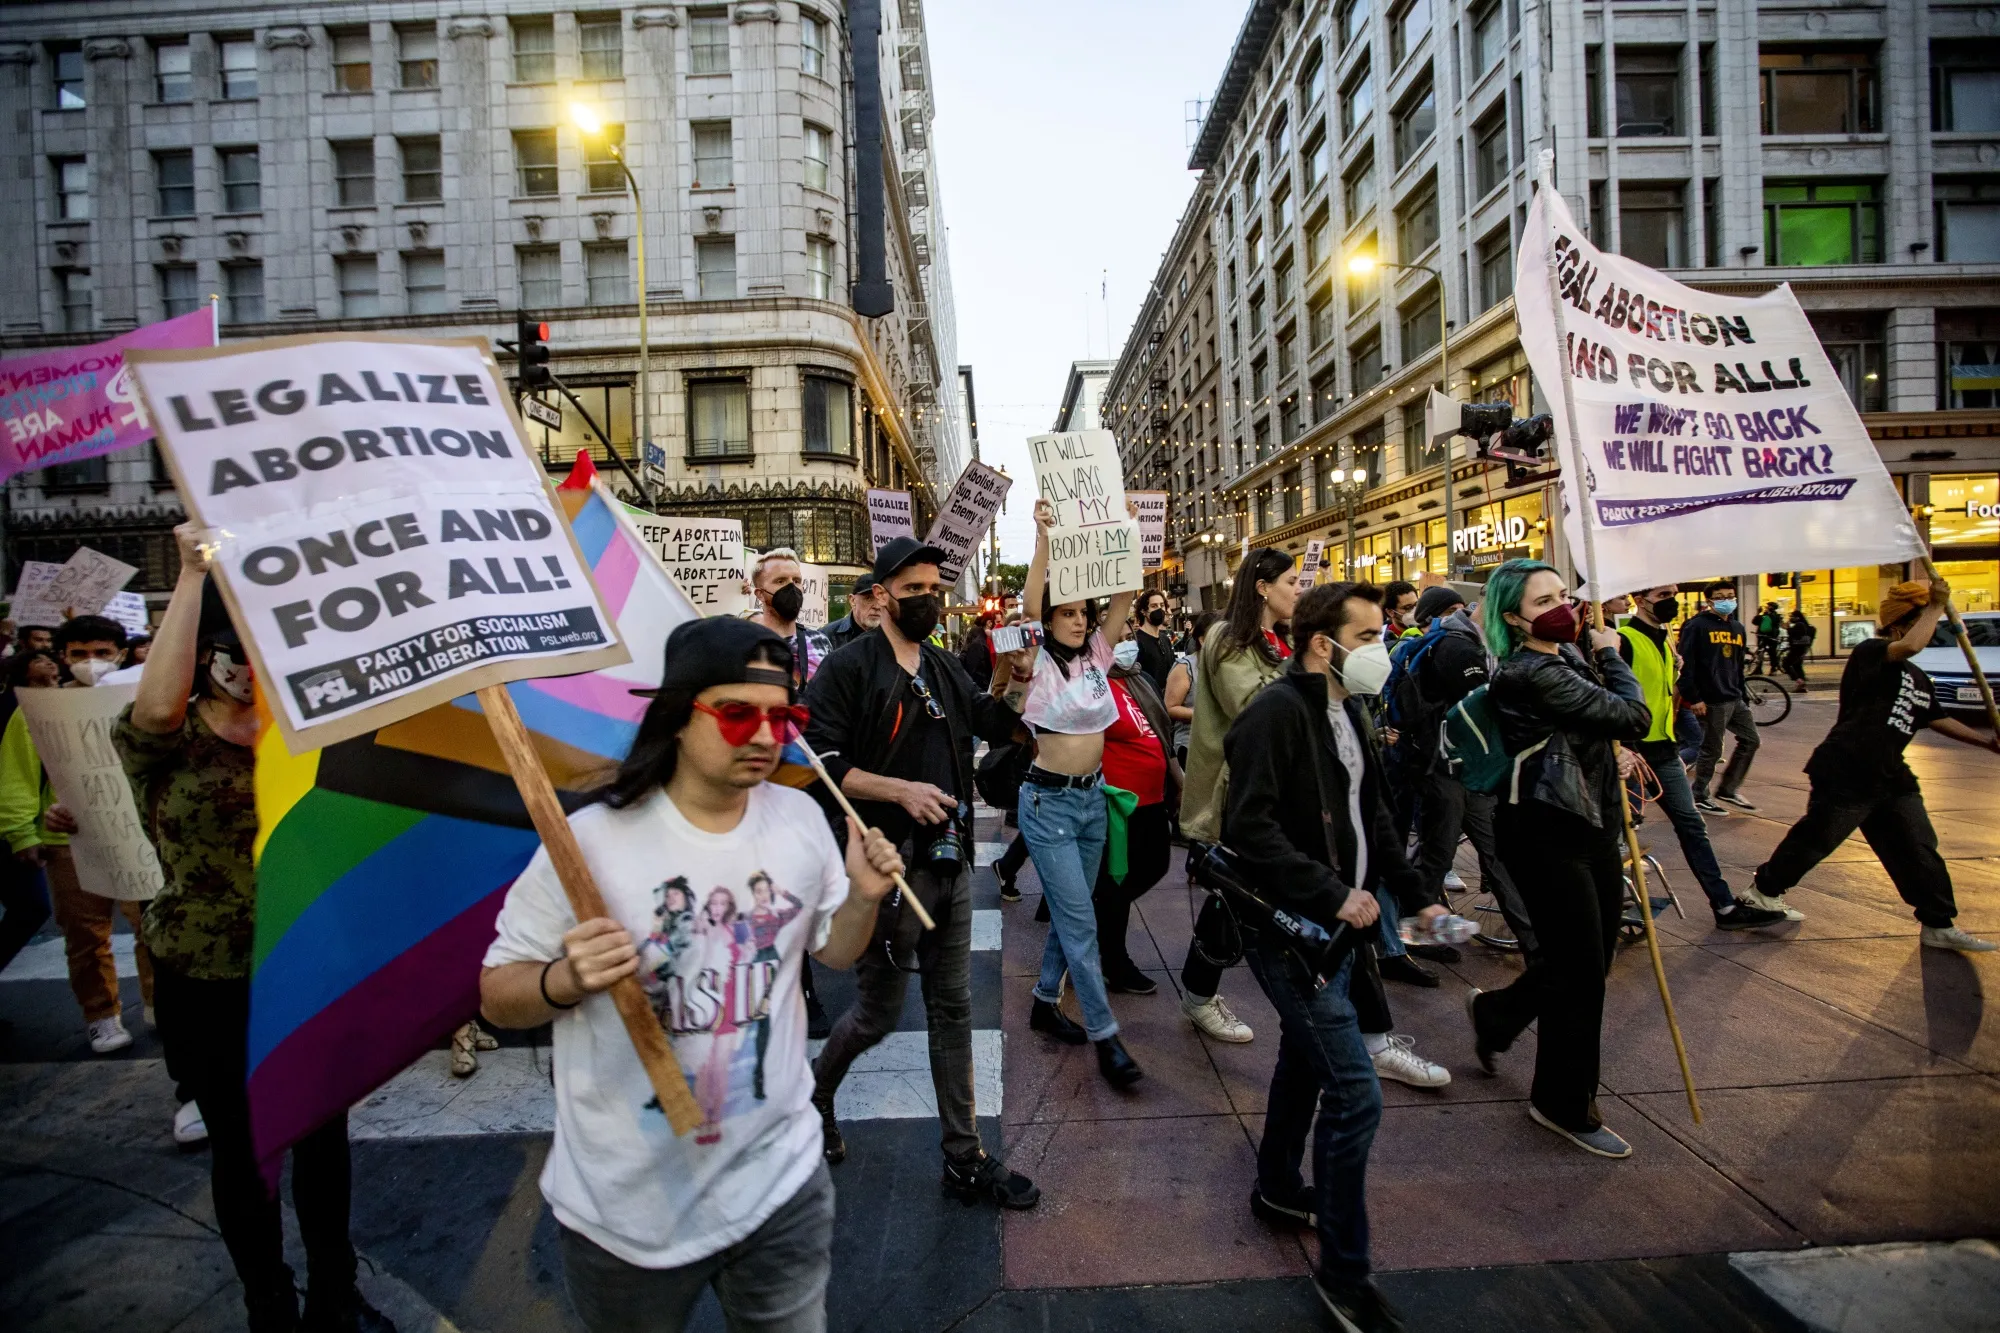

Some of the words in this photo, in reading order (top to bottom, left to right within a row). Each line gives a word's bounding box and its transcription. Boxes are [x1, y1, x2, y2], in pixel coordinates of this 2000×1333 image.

[1595, 282, 1756, 347] ABORTION
[1627, 353, 1704, 394] FOR
[1714, 357, 1811, 394] ALL!
[166, 371, 490, 432] LEGALIZE
[529, 402, 542, 417] ONE
[546, 409, 559, 423] WAY
[1614, 403, 1644, 435] WE
[1704, 412, 1734, 441] GO
[1734, 404, 1822, 442] BACK
[208, 426, 513, 496] ABORTION
[1034, 441, 1047, 463] IT
[1054, 435, 1094, 461] WILL
[1602, 439, 1626, 471] WE
[1627, 440, 1669, 473] WILL
[1673, 445, 1733, 476] FIGHT
[955, 482, 971, 500] Sup.
[966, 468, 995, 491] Abolish
[992, 484, 1004, 498] the
[1041, 465, 1104, 502] ALWAYS
[1758, 484, 1847, 499] LIBERATION
[869, 498, 909, 511] LEGALIZE
[950, 500, 976, 525] Enemy
[977, 515, 986, 529] of
[1079, 496, 1111, 523] MY
[1131, 501, 1164, 510] GALIZE
[872, 513, 911, 526] ABORTION
[1139, 515, 1163, 523] RTION
[242, 512, 429, 586] ONCE
[441, 509, 552, 543] AND
[636, 525, 670, 543] EEP
[672, 528, 742, 543] ABORTION
[939, 524, 974, 550] Women!
[1052, 531, 1090, 561] BODY
[1105, 528, 1131, 551] MY
[1145, 535, 1162, 543] AND
[1453, 524, 1488, 553] RITE
[1492, 516, 1526, 545] AID
[662, 543, 733, 562] LEGAL
[674, 567, 744, 581] ABORTION
[1059, 557, 1127, 596] CHOICE
[272, 571, 435, 649] FOR
[448, 555, 572, 599] ALL!
[356, 637, 428, 674] PARTY
[431, 621, 474, 648] FOR
[477, 613, 569, 635] SOCIALISM
[540, 630, 598, 647] PSLweb.org
[1709, 631, 1744, 647] UCLA
[368, 666, 413, 695] AND
[417, 635, 530, 676] LIBERATION
[303, 675, 358, 710] PSL
[1274, 909, 1301, 933] PYLE
